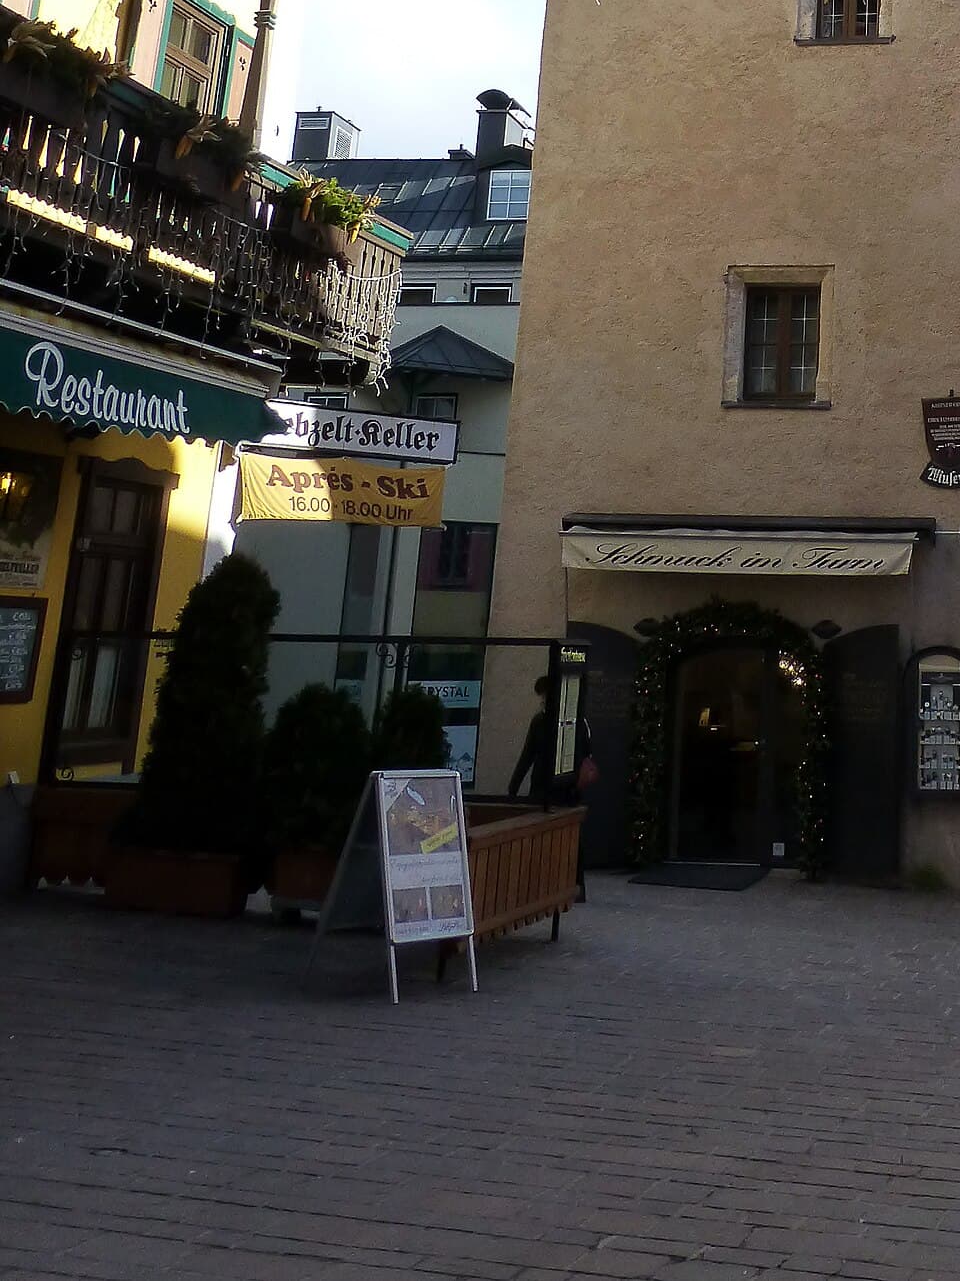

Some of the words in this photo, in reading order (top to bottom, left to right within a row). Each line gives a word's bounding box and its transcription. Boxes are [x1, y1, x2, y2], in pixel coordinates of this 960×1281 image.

[25, 341, 190, 434] Restaurant
[377, 475, 430, 500] Ski
[289, 496, 330, 512] 16.00
[340, 501, 382, 518] 18.00
[386, 504, 413, 521] Uhr
[586, 543, 741, 569] Schmuck
[741, 552, 783, 569] im
[792, 547, 885, 570] Turm
